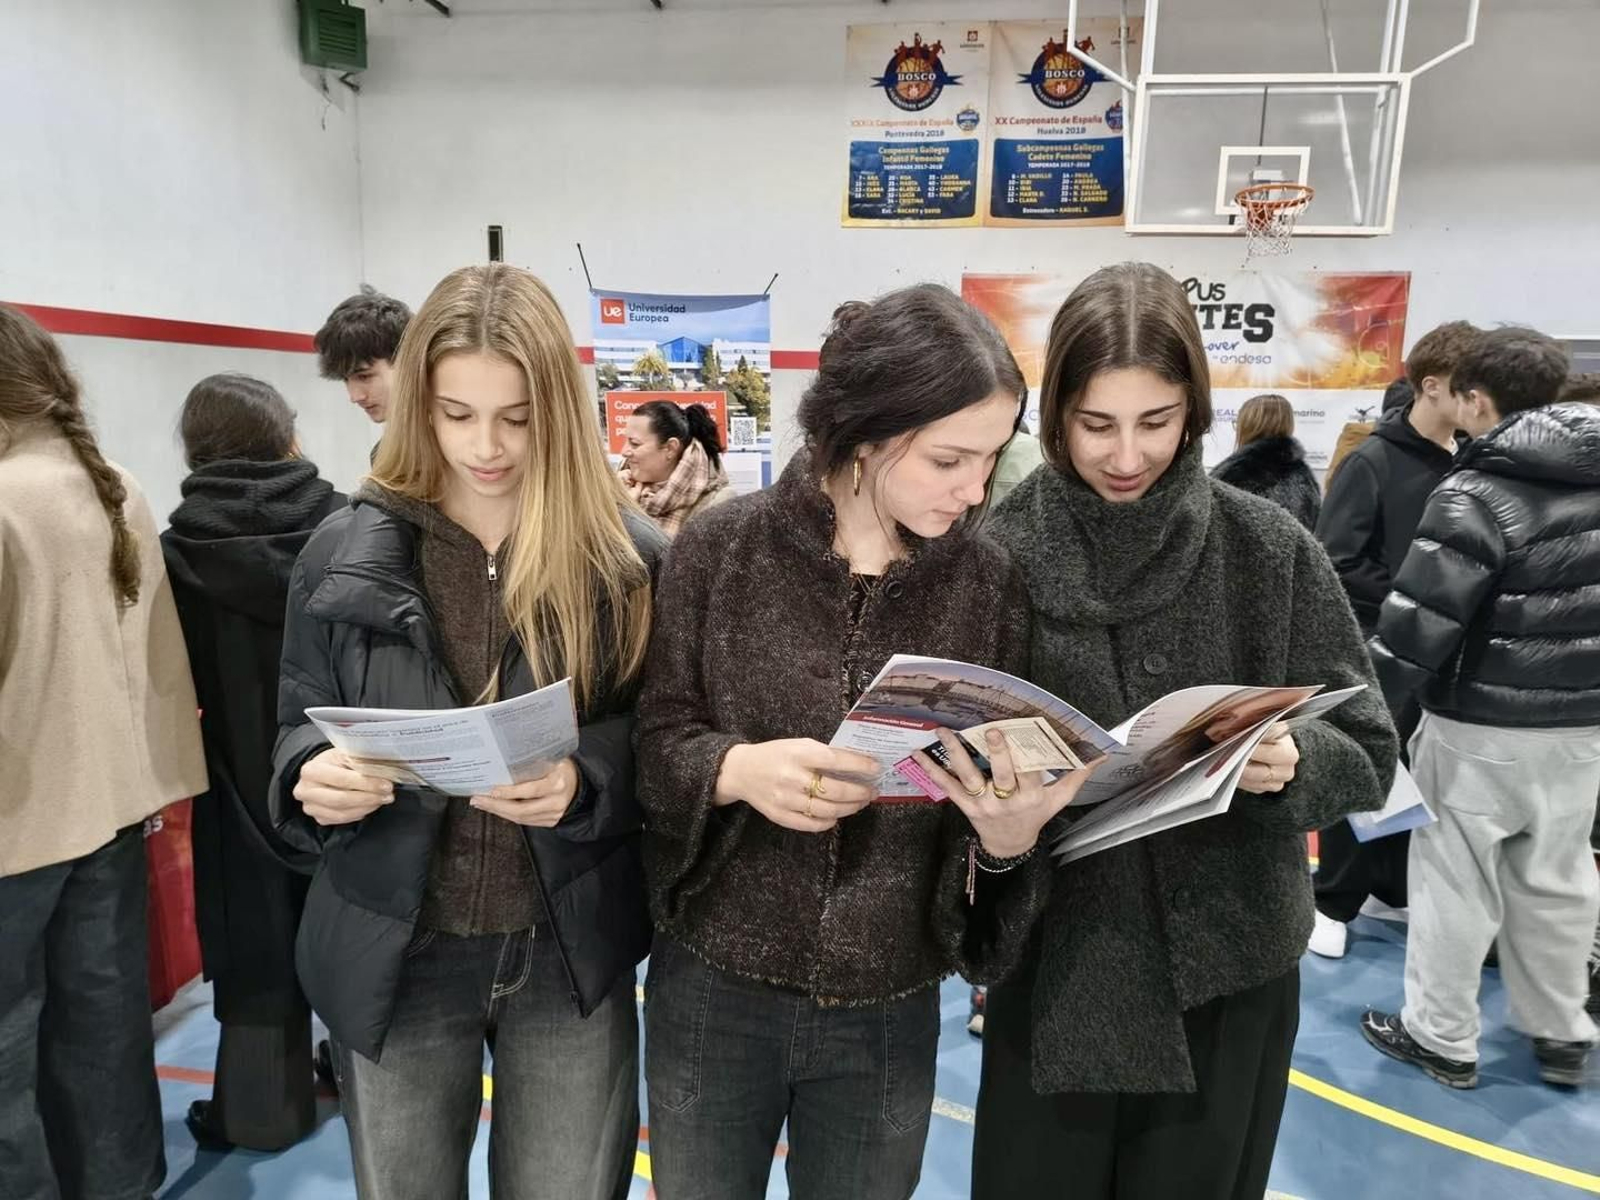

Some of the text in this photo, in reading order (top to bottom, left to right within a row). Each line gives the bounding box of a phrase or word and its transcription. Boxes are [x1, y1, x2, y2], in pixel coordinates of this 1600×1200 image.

[898, 72, 937, 81] BOSCO
[1045, 69, 1085, 78] BOSCO
[876, 118, 919, 128] Campeonato
[920, 118, 928, 126] de
[929, 117, 954, 127] España
[995, 117, 1008, 125] XX
[1009, 116, 1059, 126] Campeonato
[1060, 115, 1070, 124] de
[1072, 115, 1103, 125] España
[885, 129, 944, 138] Pontevedra 2018
[1037, 126, 1086, 135] Huelva 2018
[878, 146, 950, 157] Campeonas Gallegas
[1016, 143, 1105, 153] Subcampeonas Gallegas
[910, 155, 945, 163] Femenino
[1055, 152, 1092, 160] Femenino
[603, 305, 622, 318] ue
[629, 303, 686, 314] Universidad
[629, 313, 669, 323] Europea
[1192, 303, 1275, 343] TES
[1220, 353, 1272, 364] endesa
